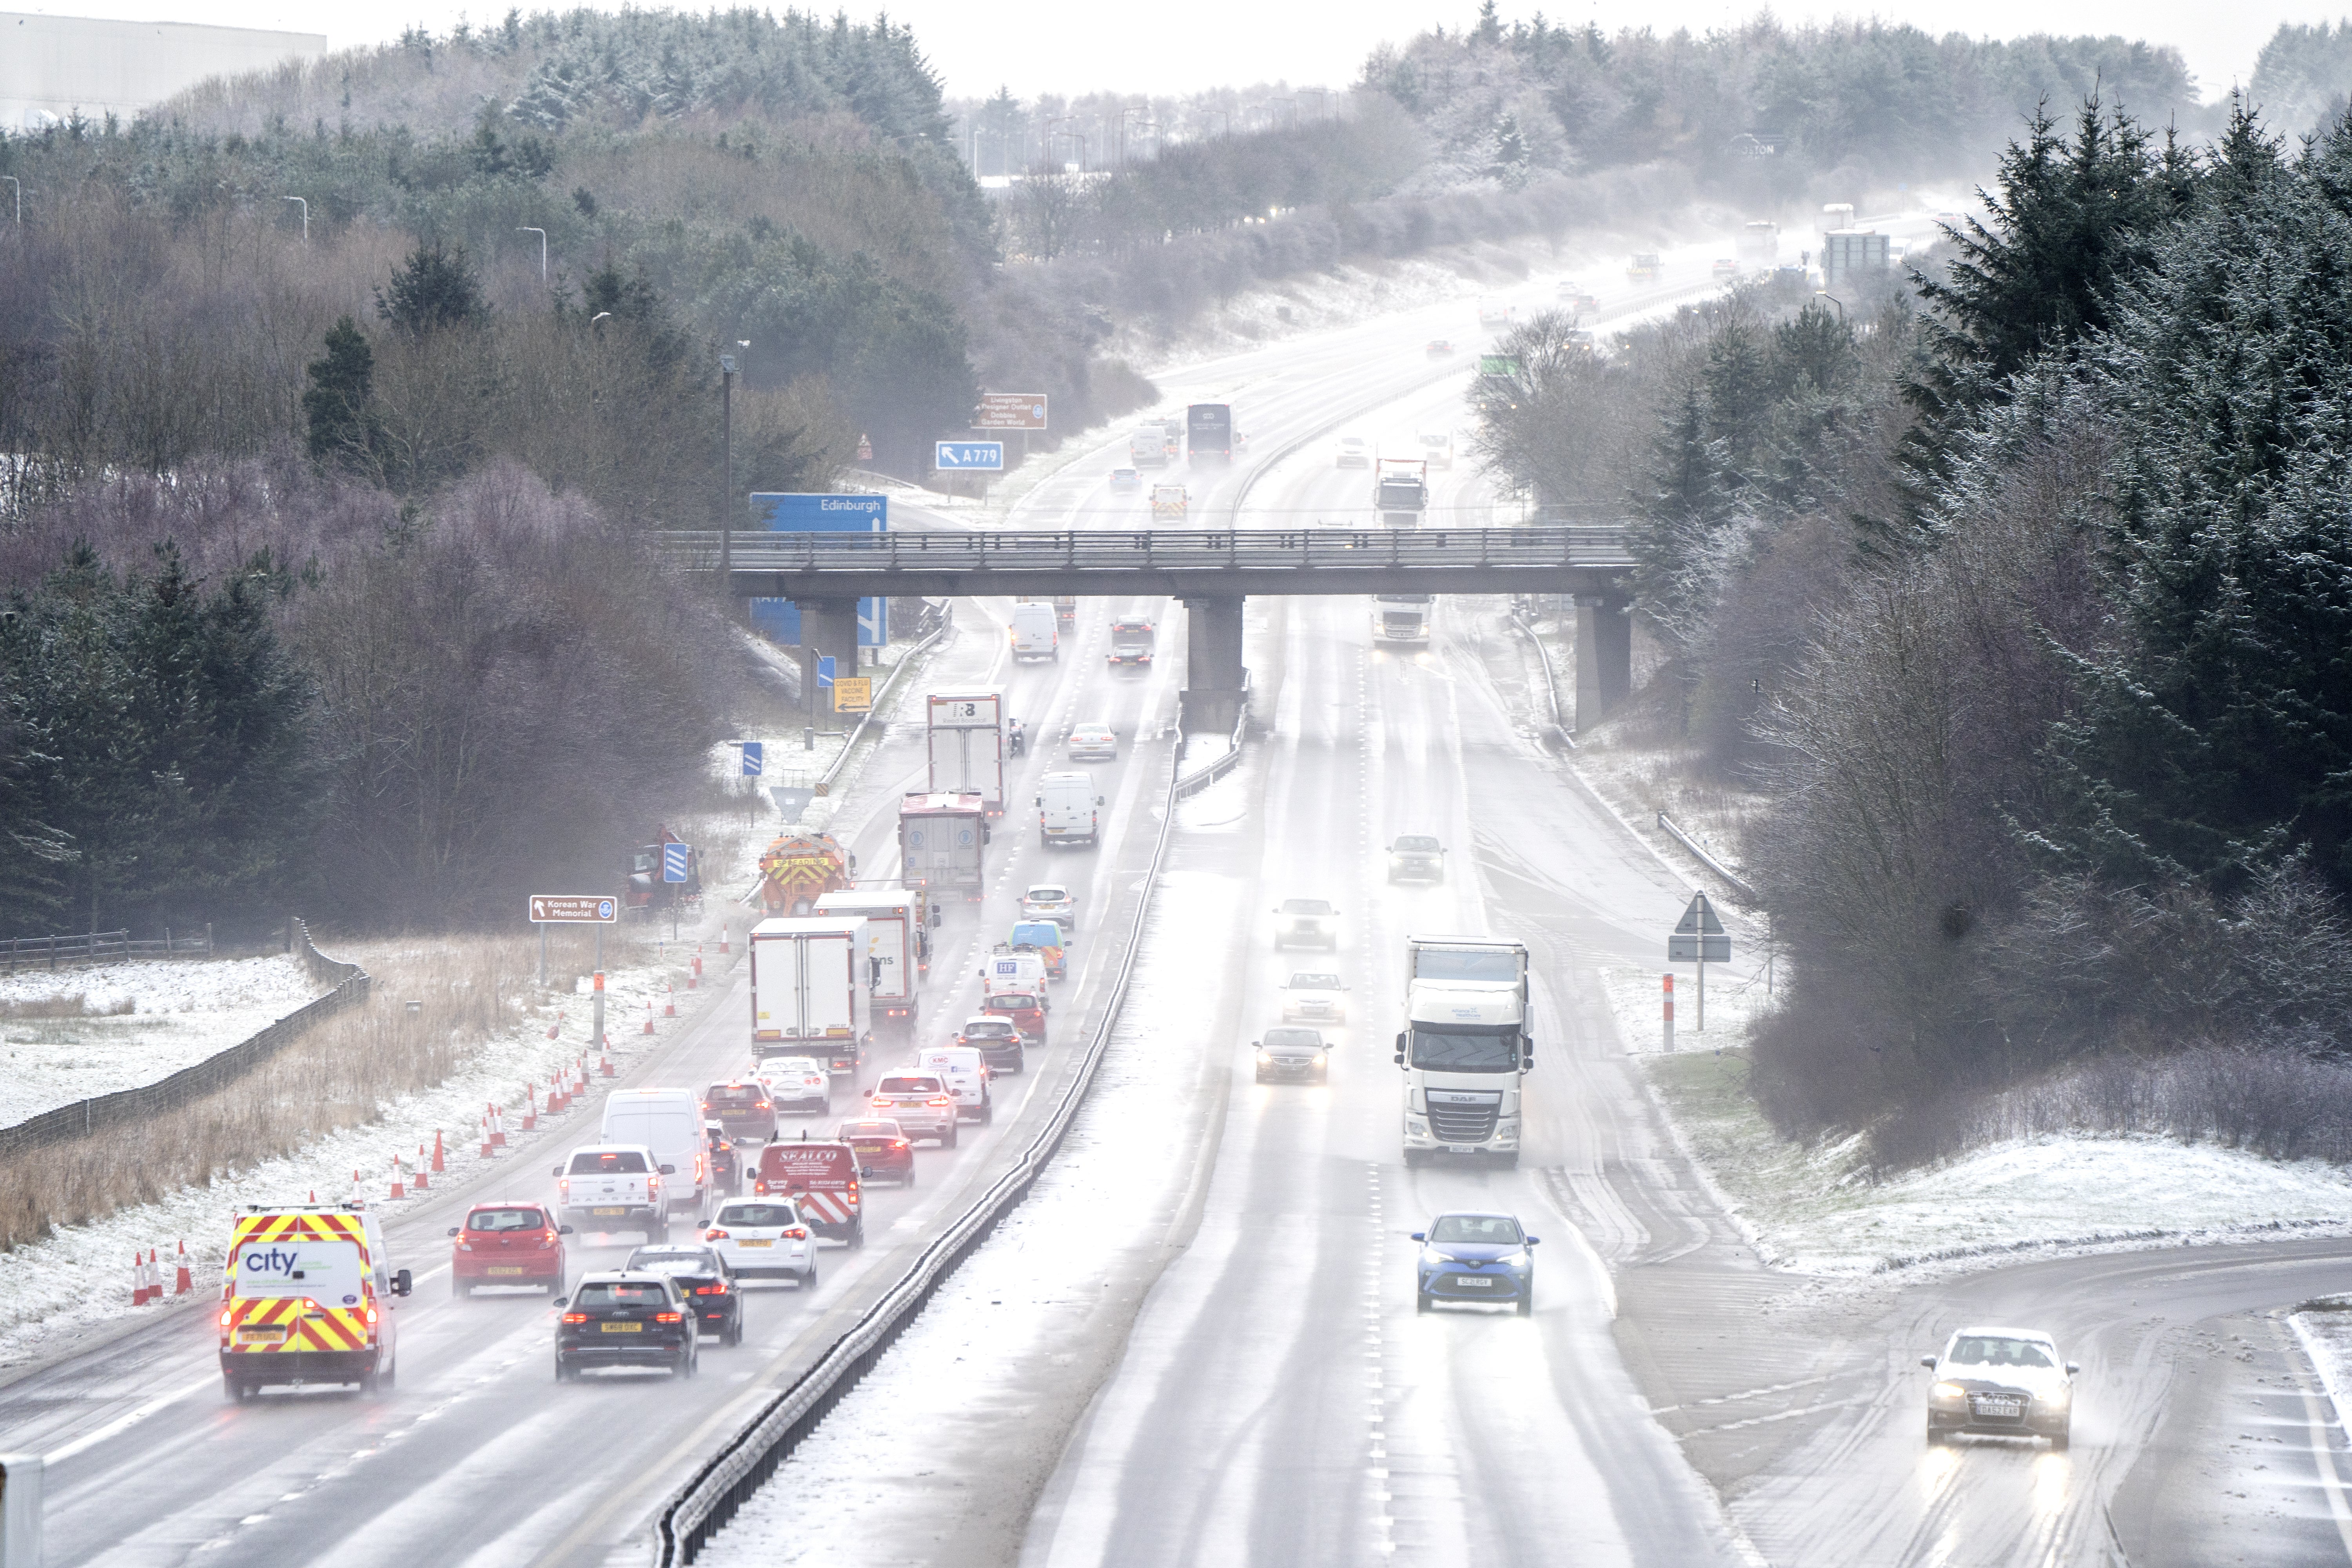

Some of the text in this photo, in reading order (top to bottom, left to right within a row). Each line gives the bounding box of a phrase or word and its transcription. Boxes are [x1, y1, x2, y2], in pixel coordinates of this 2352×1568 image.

[963, 449, 996, 462] A779
[821, 499, 880, 513] Edinburgh
[999, 964, 1014, 972] HF
[779, 1151, 837, 1162] SEALCO
[246, 1248, 298, 1276] city
